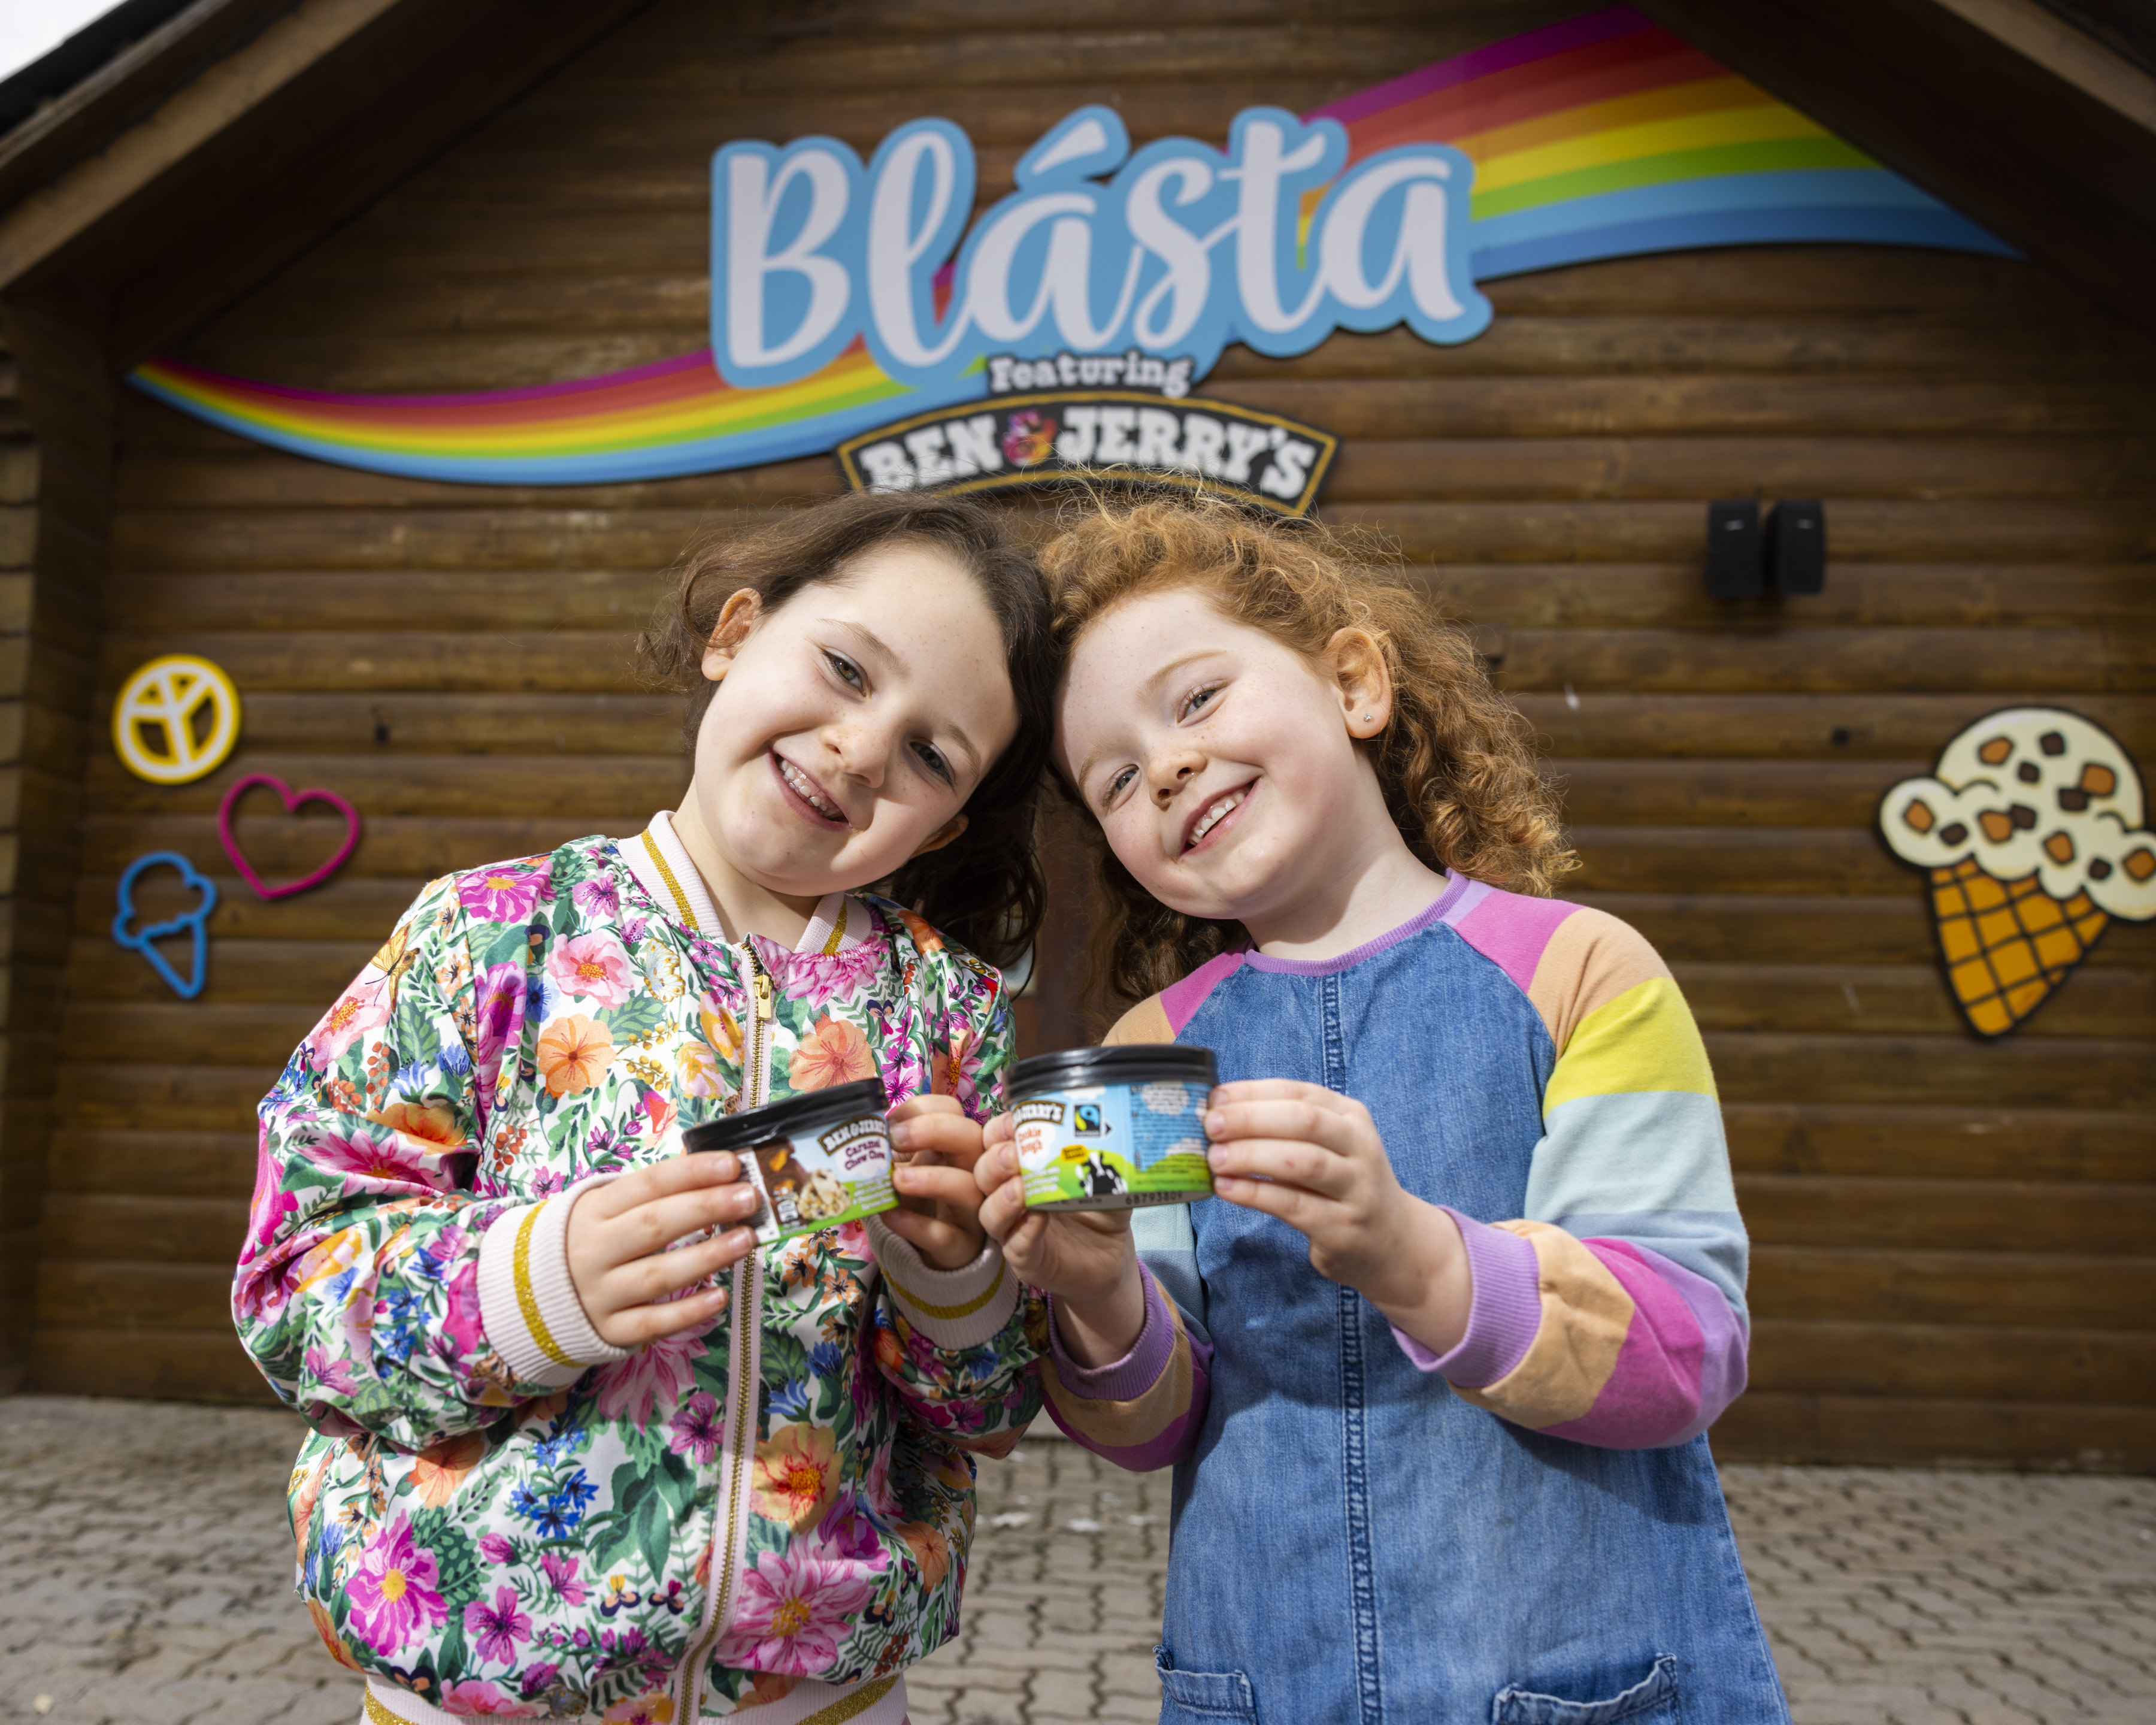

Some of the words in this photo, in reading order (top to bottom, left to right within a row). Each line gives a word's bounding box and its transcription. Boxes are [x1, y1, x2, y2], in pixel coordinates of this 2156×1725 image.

[728, 119, 1466, 367] Blásta
[990, 350, 1192, 398] Featuring
[859, 413, 1004, 496] BEN
[1058, 406, 1316, 499] JERRY'S
